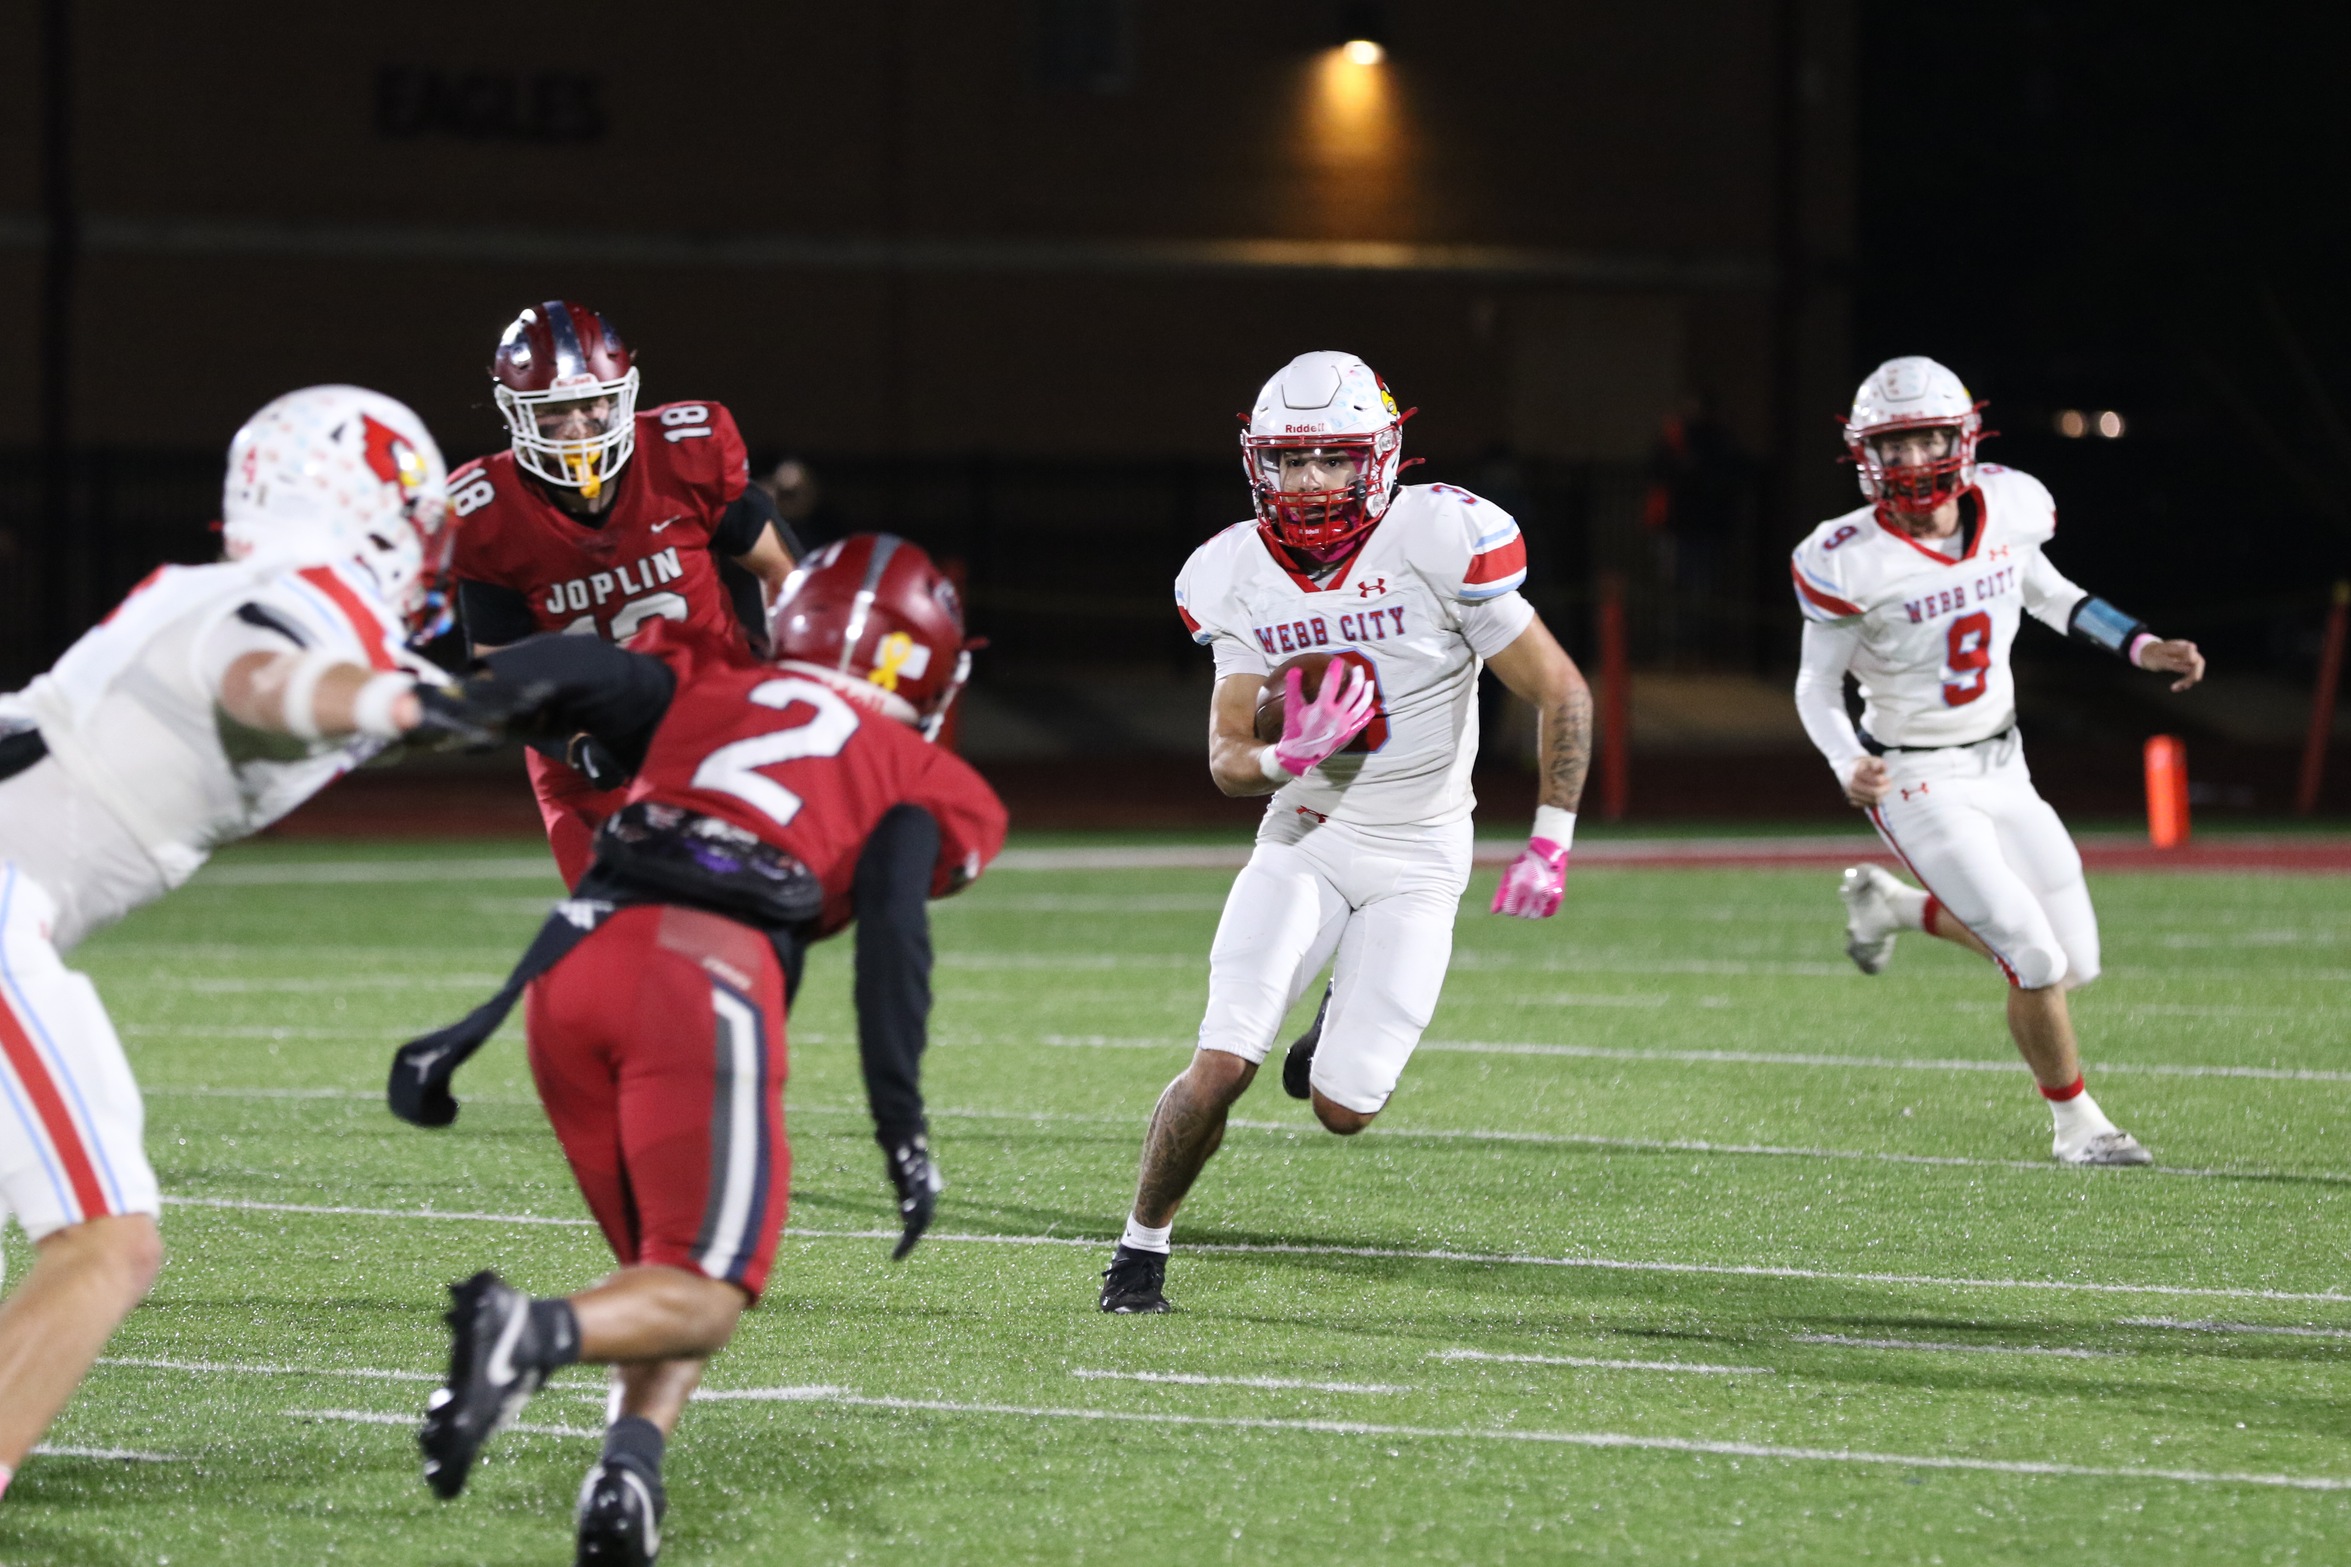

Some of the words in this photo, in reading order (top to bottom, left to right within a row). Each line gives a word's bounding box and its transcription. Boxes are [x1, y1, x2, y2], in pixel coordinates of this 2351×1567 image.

[376, 66, 606, 141] EAGLES
[659, 404, 713, 443] 18
[1284, 422, 1325, 434] Riddell
[446, 467, 496, 518] 18
[1822, 525, 1859, 551] 9
[545, 546, 685, 615] JOPLIN
[1904, 586, 1967, 625] WEBB
[1975, 566, 2015, 602] CITY
[1254, 616, 1330, 655] WEBB
[1339, 605, 1406, 642] CITY
[1941, 608, 1993, 708] 9
[688, 677, 860, 827] 2
